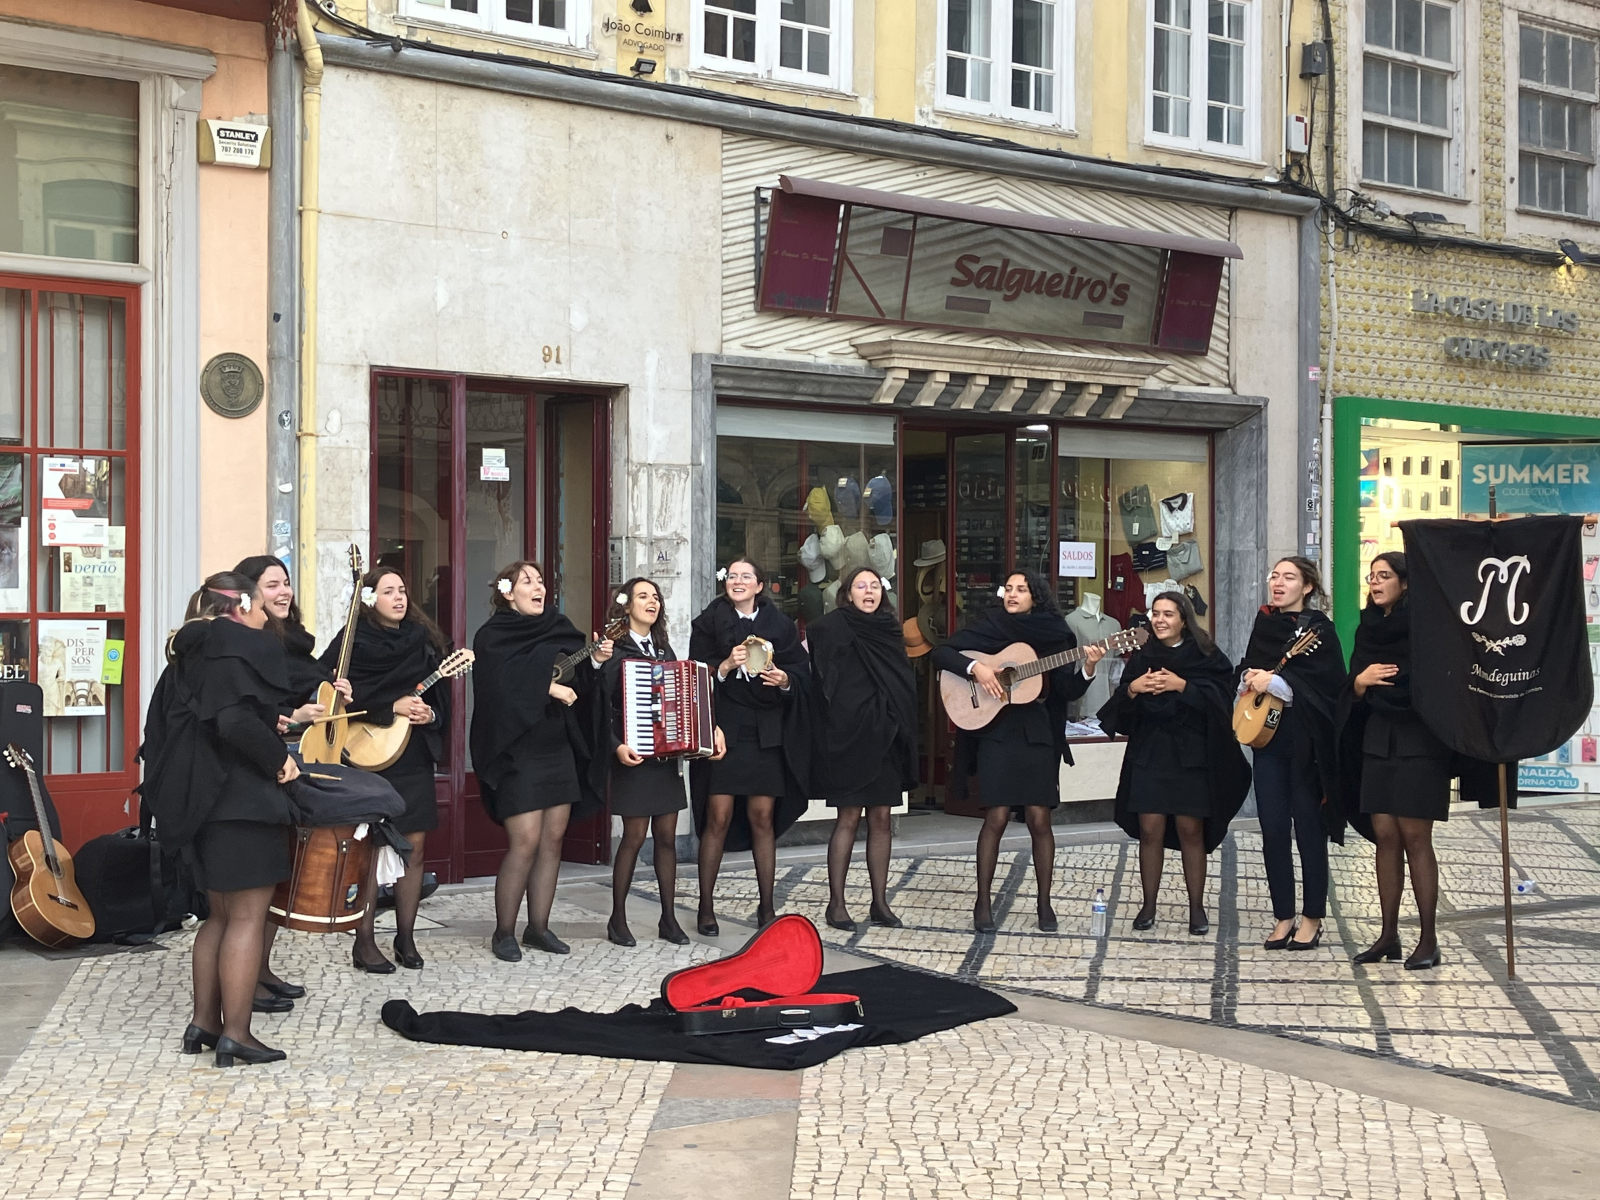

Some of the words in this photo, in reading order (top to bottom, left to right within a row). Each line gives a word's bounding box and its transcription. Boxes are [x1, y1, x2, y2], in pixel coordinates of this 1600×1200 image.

[604, 17, 631, 33] João
[635, 23, 684, 43] Coimbra
[622, 38, 665, 52] ADVOGADO
[219, 130, 256, 141] STANLEY
[950, 253, 1131, 307] Salgueiro's
[1411, 288, 1444, 314] LA
[1445, 295, 1500, 321] CASA
[1503, 301, 1535, 326] DE
[1536, 304, 1579, 333] LAS
[541, 344, 562, 365] 91
[1444, 336, 1551, 368] CARCASAS
[1472, 463, 1591, 485] SUMMER
[1502, 487, 1560, 497] COLLECTION
[656, 550, 671, 562] AL
[1062, 550, 1094, 561] SALDOS
[74, 560, 117, 574] verão
[66, 638, 84, 647] DIS
[75, 647, 95, 656] PER
[1557, 779, 1577, 787] TEU
